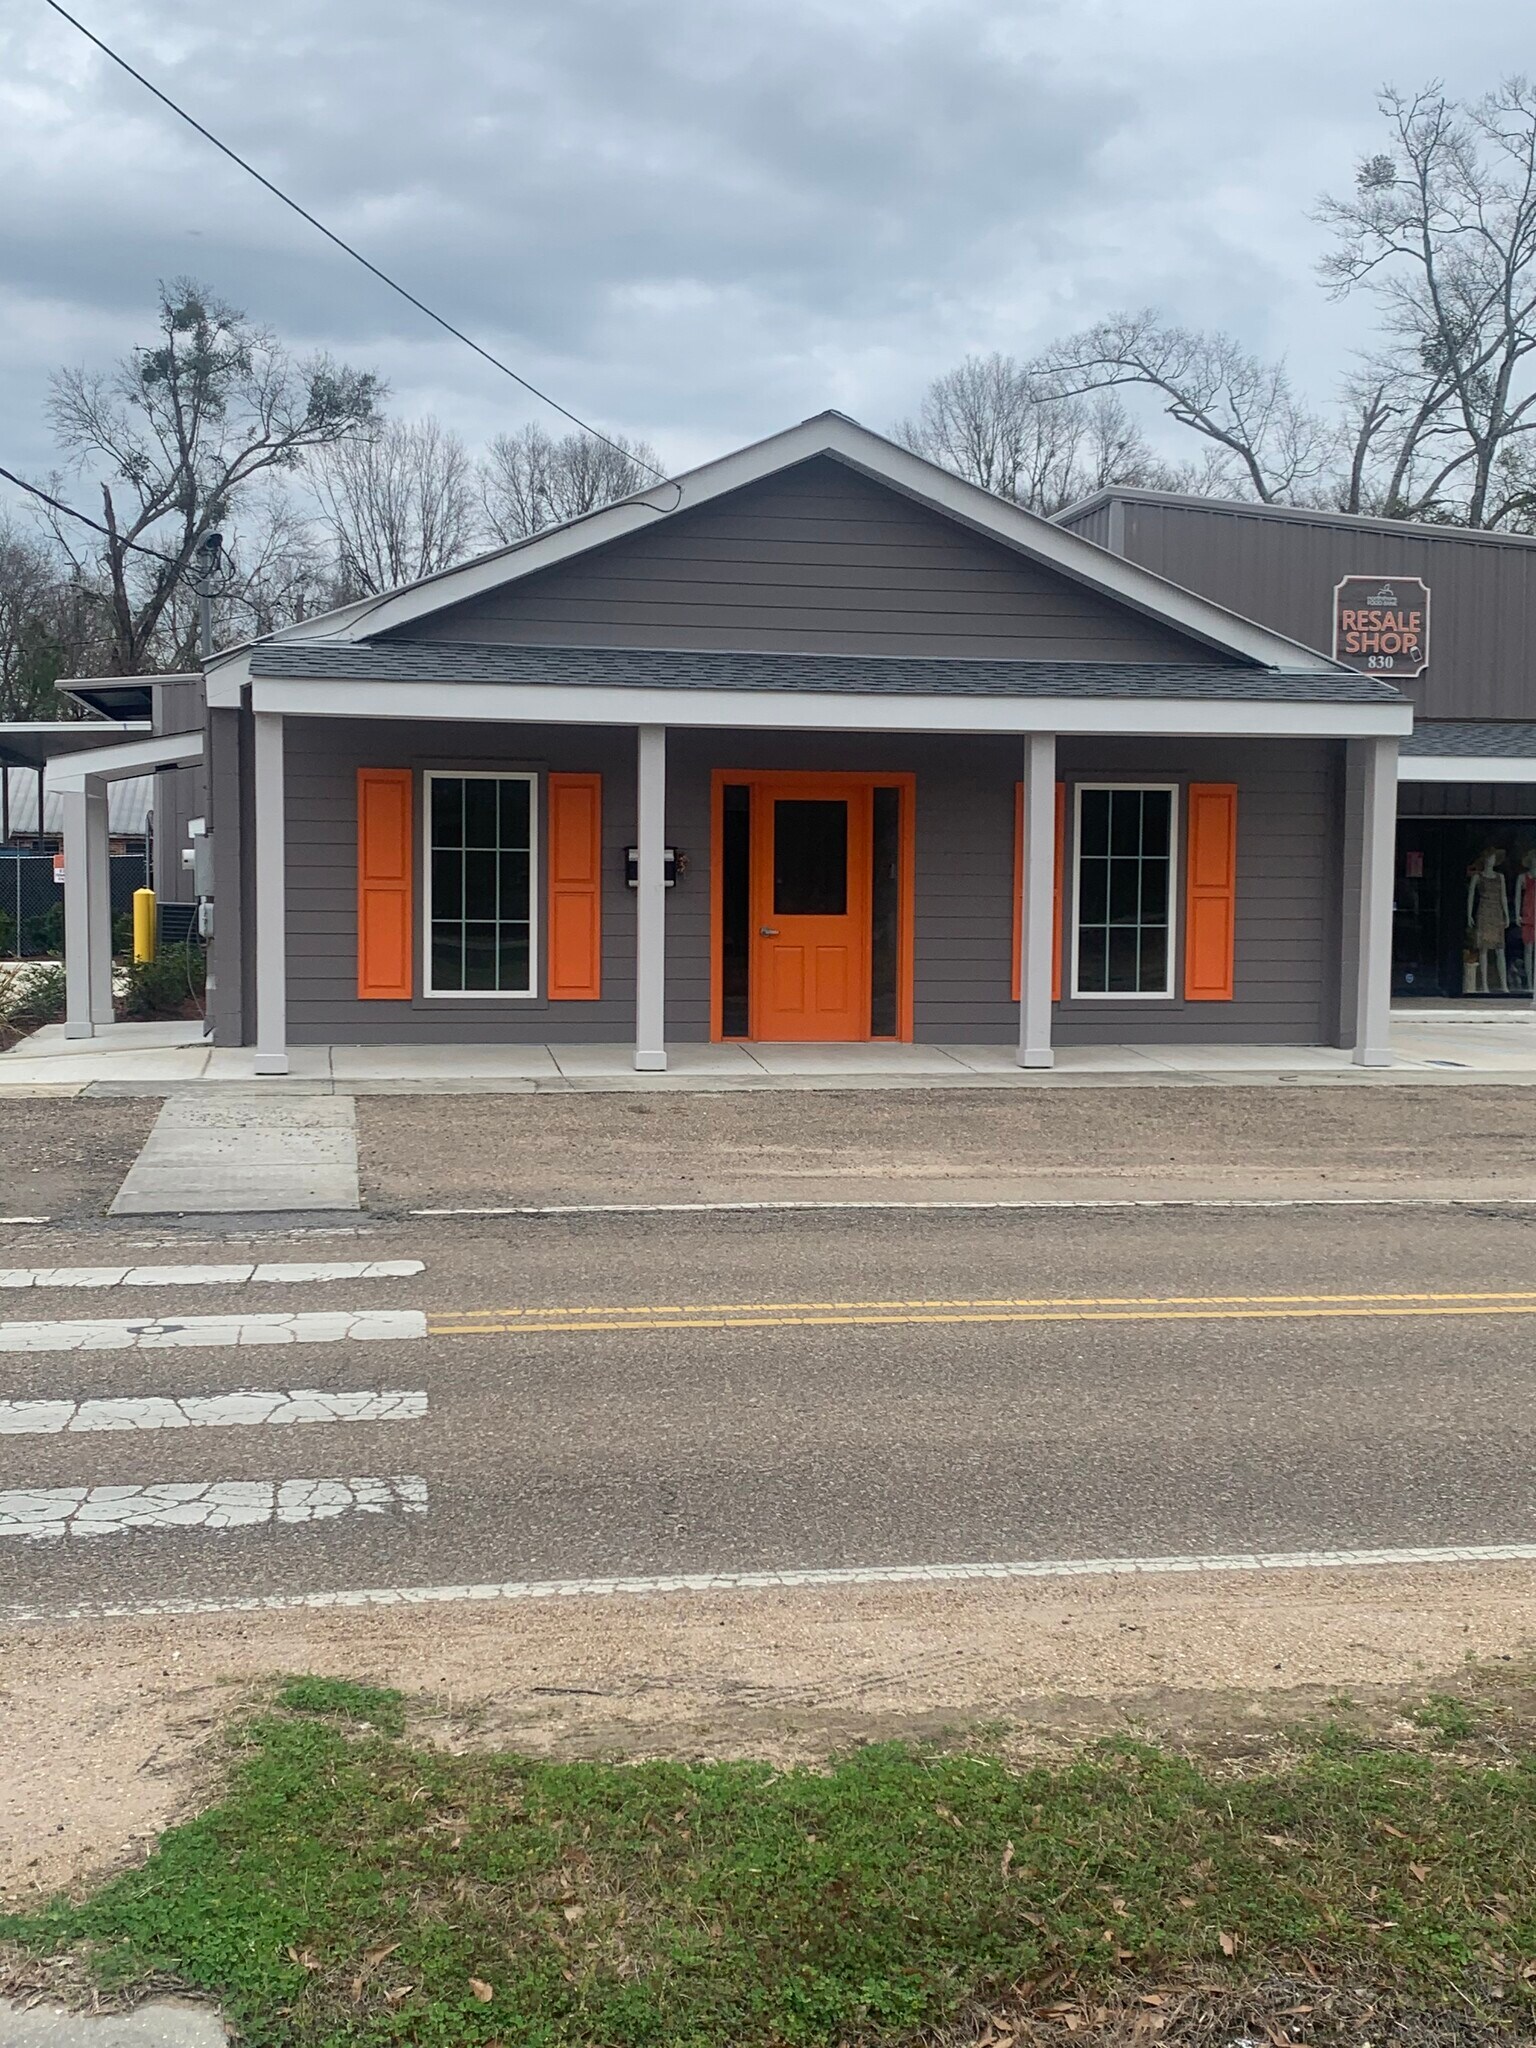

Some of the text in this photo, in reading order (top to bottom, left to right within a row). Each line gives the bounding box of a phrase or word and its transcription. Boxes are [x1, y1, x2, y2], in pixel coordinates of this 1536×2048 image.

[1342, 609, 1421, 632] RESALE
[1345, 631, 1418, 654] SHOP
[1368, 655, 1394, 669] 830
